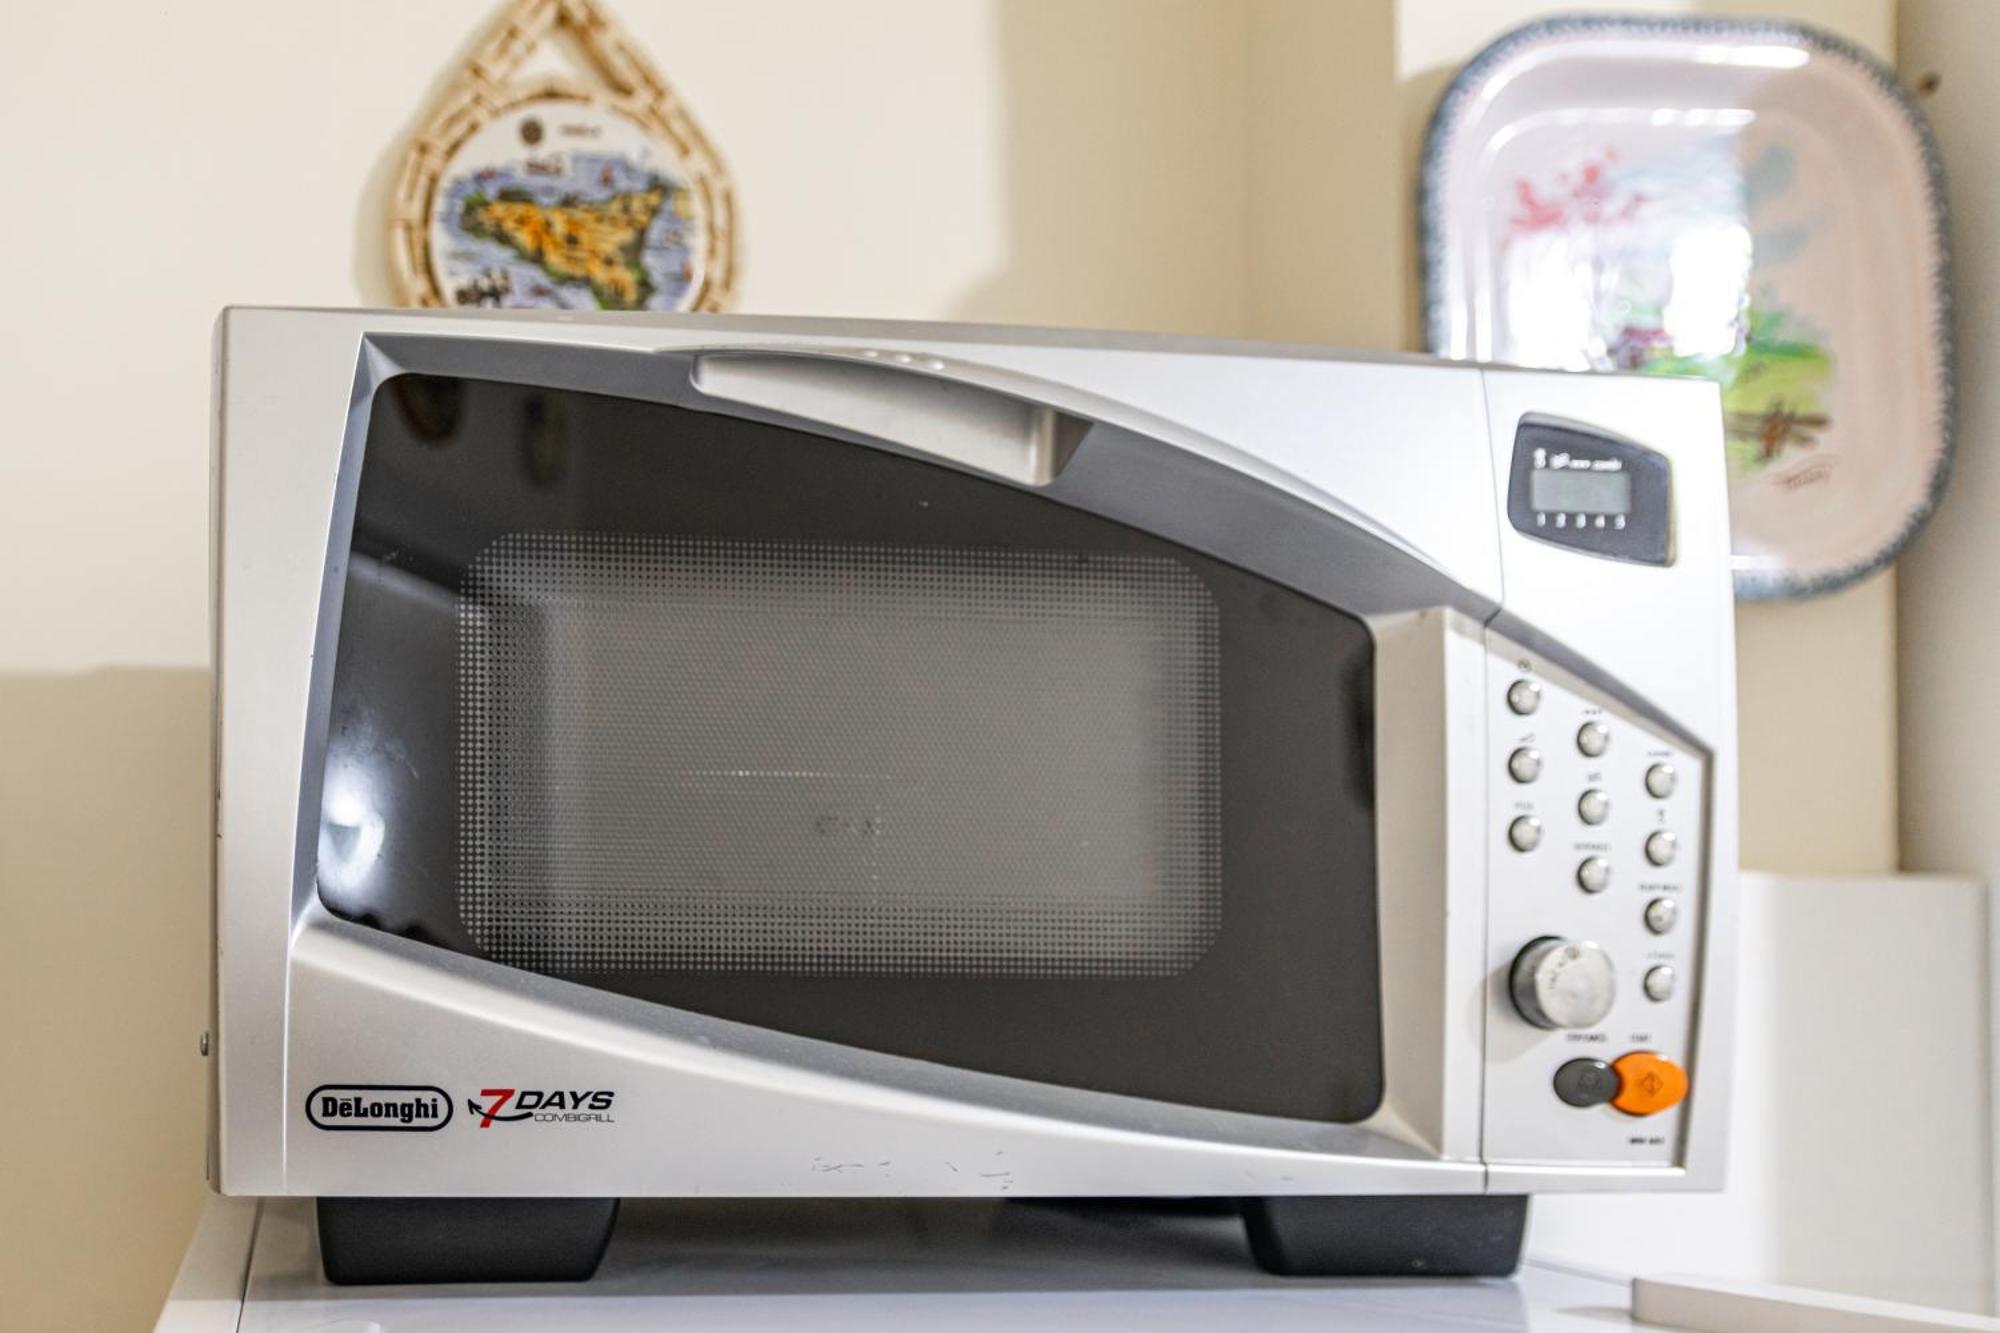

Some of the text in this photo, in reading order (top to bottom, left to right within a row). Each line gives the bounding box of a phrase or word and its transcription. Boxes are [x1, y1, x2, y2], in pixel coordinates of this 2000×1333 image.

[480, 1089, 615, 1128] 7 DAYS
[534, 1113, 615, 1123] COMBIGRILL
